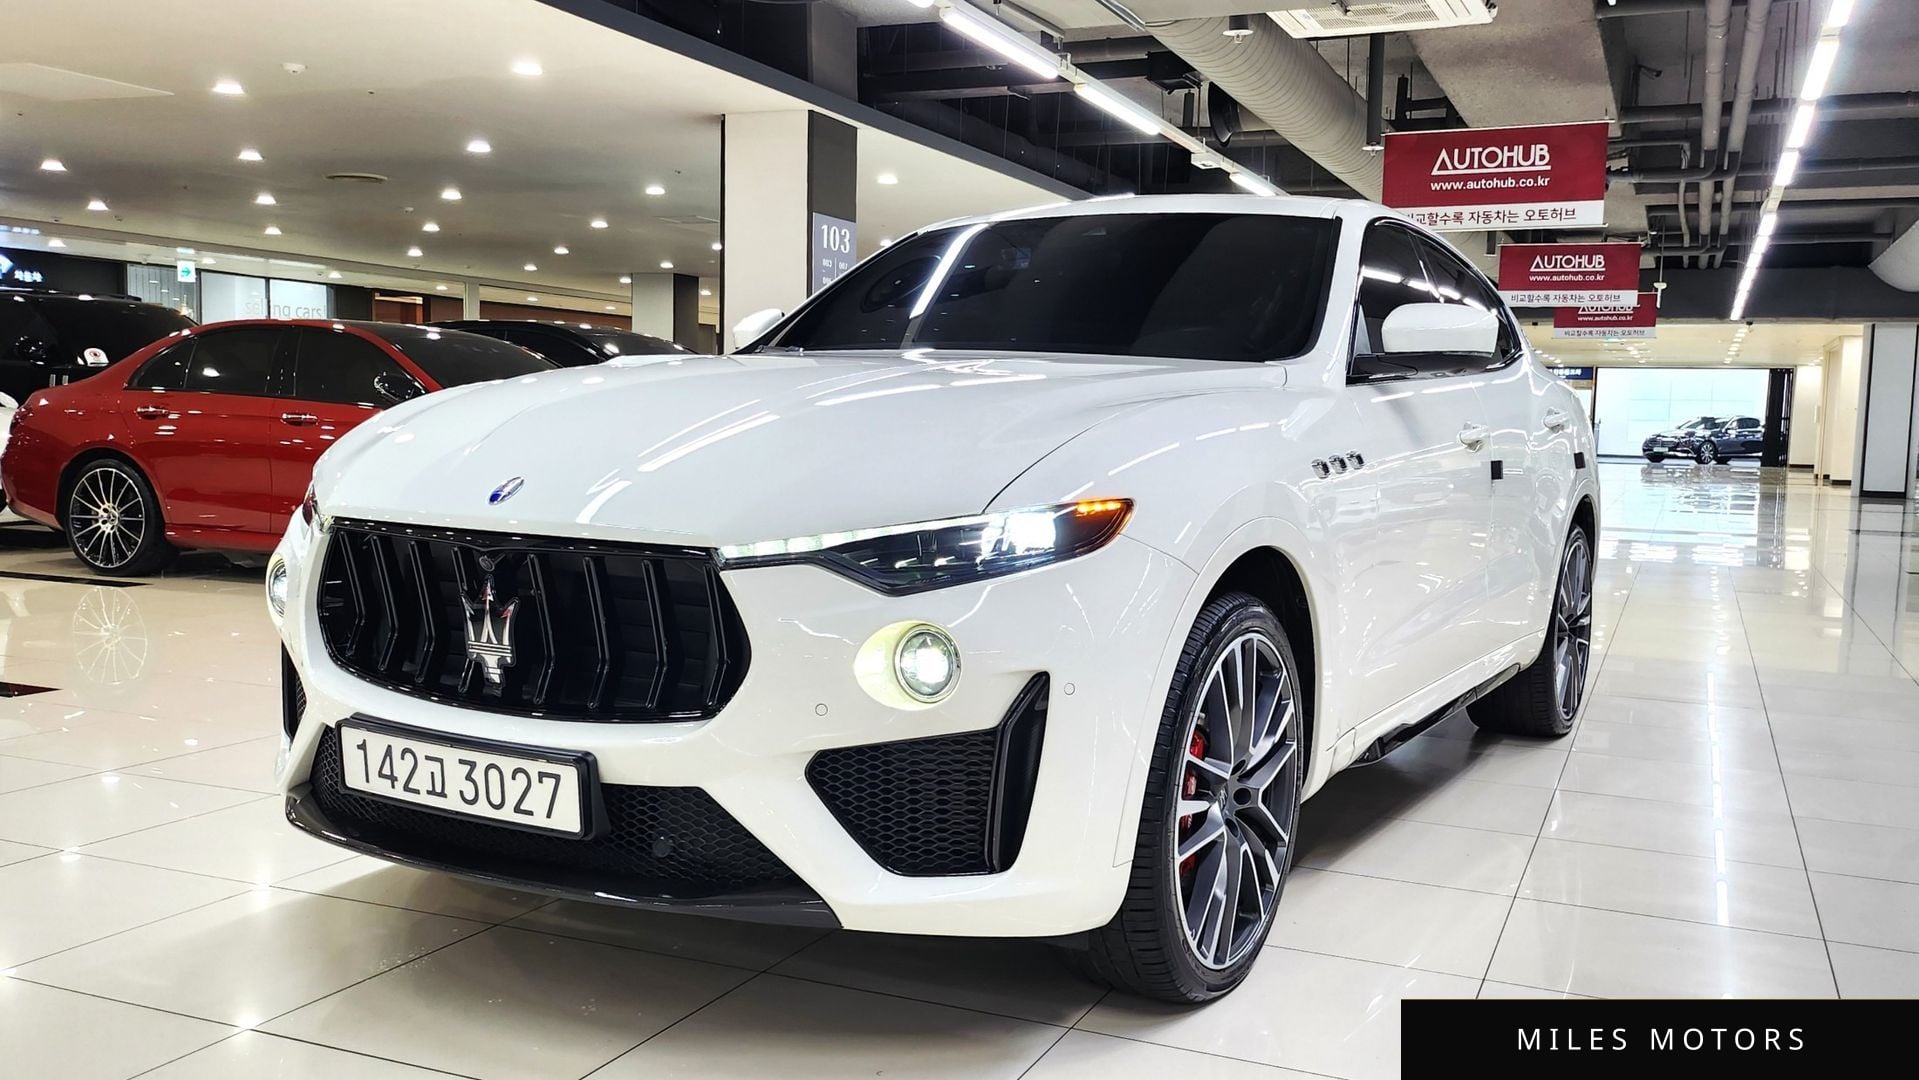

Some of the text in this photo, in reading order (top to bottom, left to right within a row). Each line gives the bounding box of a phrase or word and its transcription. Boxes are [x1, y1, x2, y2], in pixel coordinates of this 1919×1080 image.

[1431, 144, 1551, 175] AUTOHUB
[1431, 176, 1551, 191] www.autohub.co.kr
[1468, 209, 1519, 225] 자동차는
[1523, 207, 1577, 222] 오토허브
[821, 225, 850, 253] 103
[1530, 255, 1606, 271] AUTOHUB
[1529, 274, 1606, 282] www.autohub.co.kr
[1511, 293, 1621, 304] 비교할수록 자동차는 오토허브
